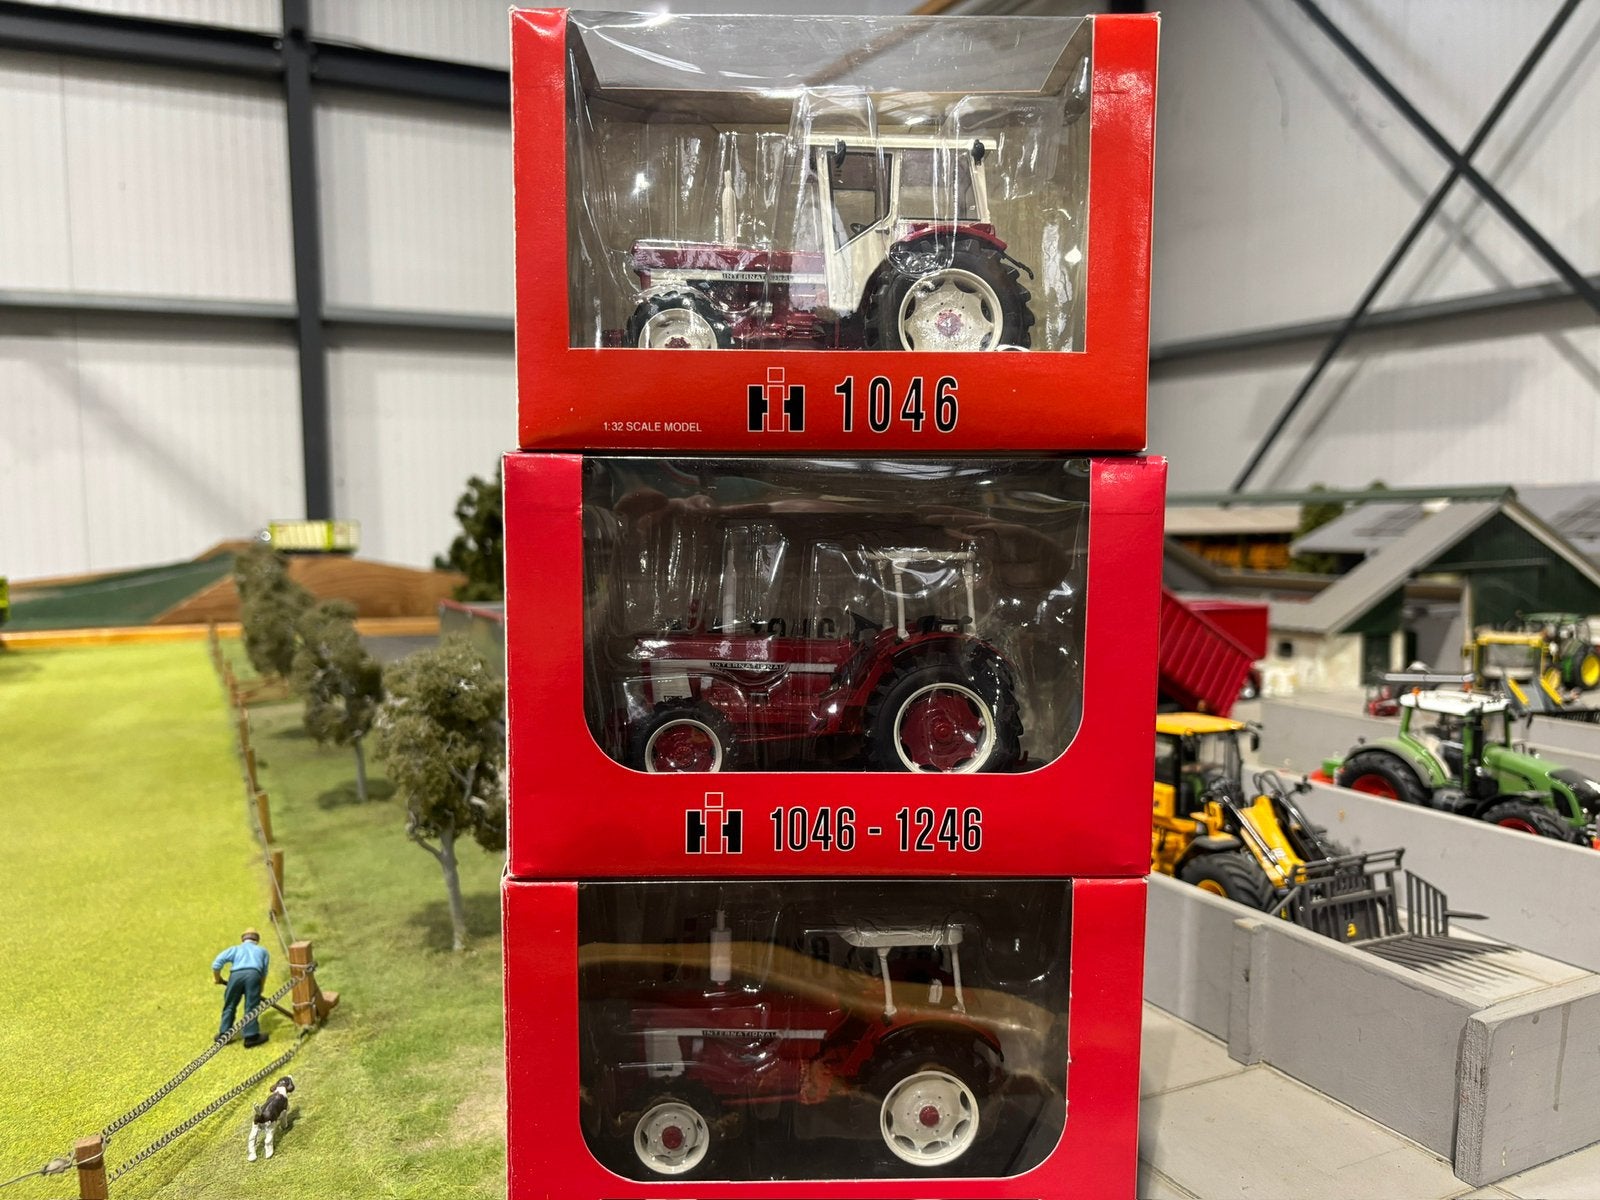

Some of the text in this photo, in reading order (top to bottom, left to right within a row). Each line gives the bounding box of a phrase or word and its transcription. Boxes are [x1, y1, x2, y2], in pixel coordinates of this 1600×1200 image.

[722, 272, 793, 282] INTERNATONAL
[834, 375, 959, 433] 1046
[603, 421, 702, 432] 1:32 SCALE MODEL
[770, 806, 856, 852] 1046
[895, 806, 983, 852] 1246
[702, 1030, 777, 1038] INTERNATIONAL
